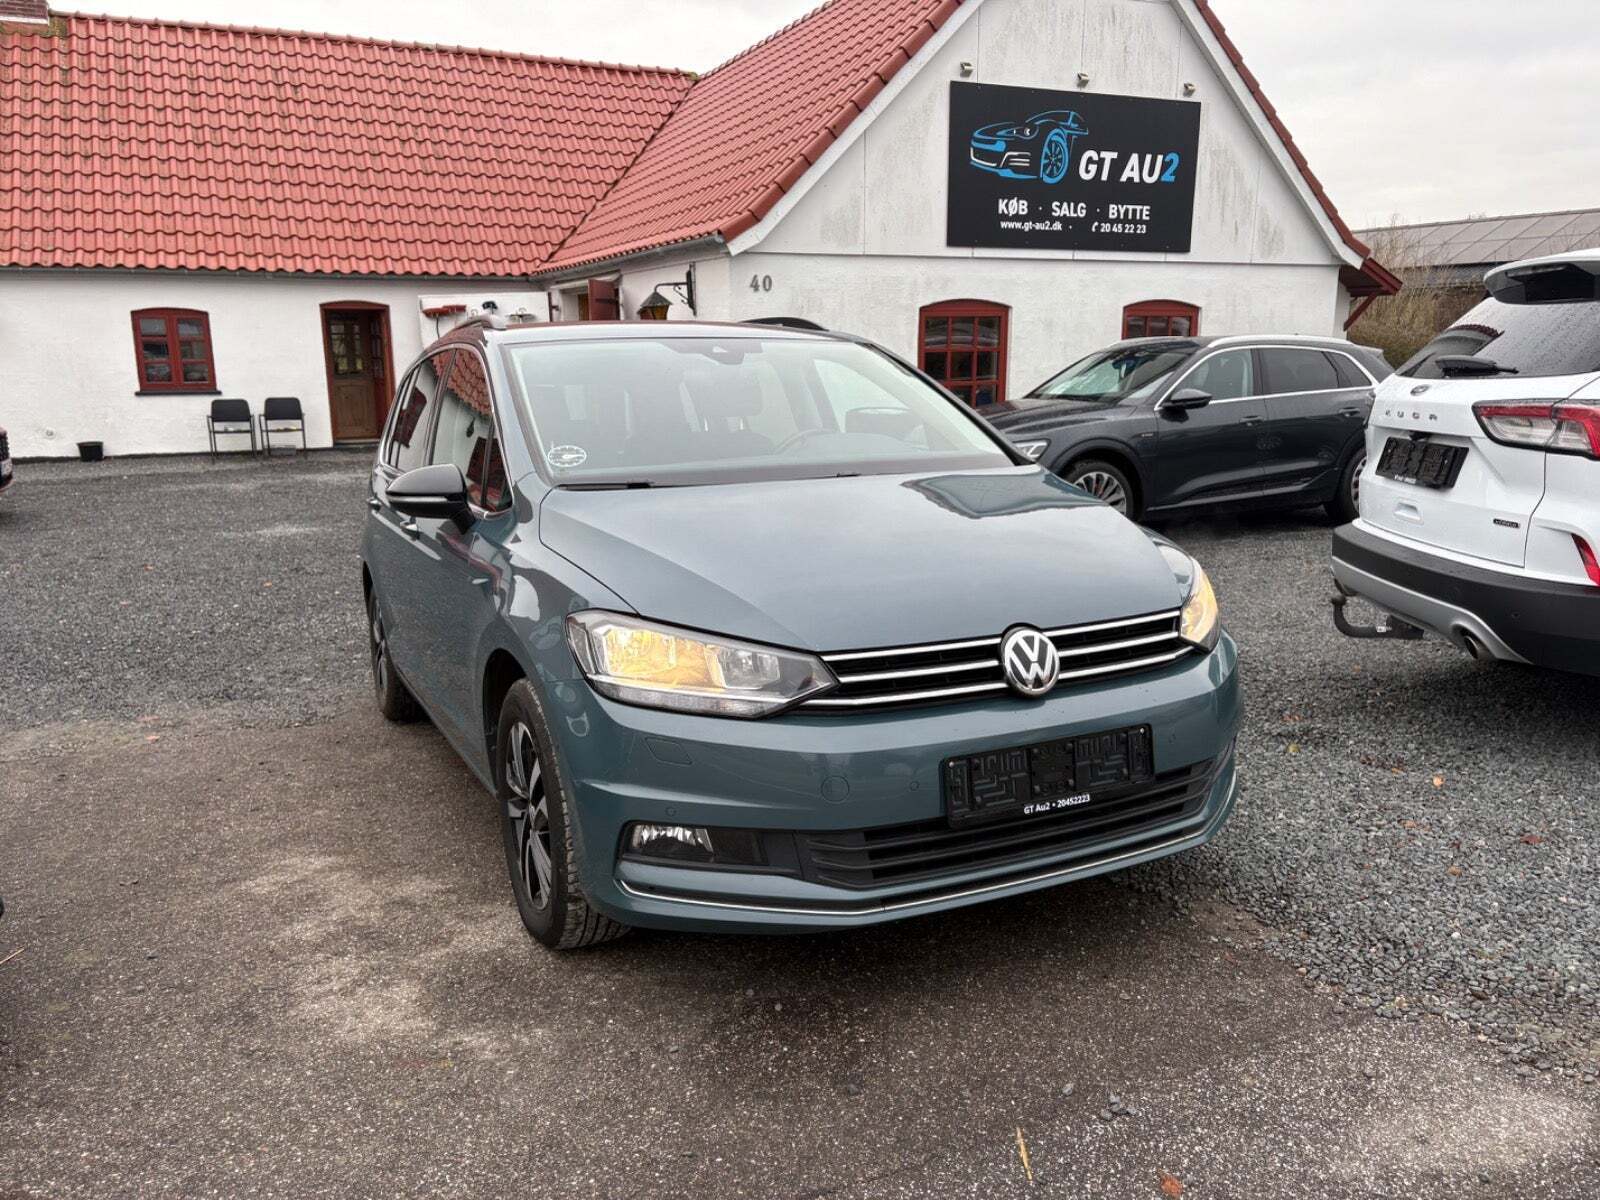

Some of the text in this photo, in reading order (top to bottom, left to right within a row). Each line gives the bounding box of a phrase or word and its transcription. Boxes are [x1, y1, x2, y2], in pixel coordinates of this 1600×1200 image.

[1078, 149, 1181, 184] GT AU2
[998, 197, 1151, 220] KØB SALG BYTTE
[1000, 220, 1147, 234] www.gt-au2.dk 20 45 22 23
[750, 274, 773, 292] 40
[1023, 804, 1034, 815] GT
[1035, 801, 1051, 812] Au2
